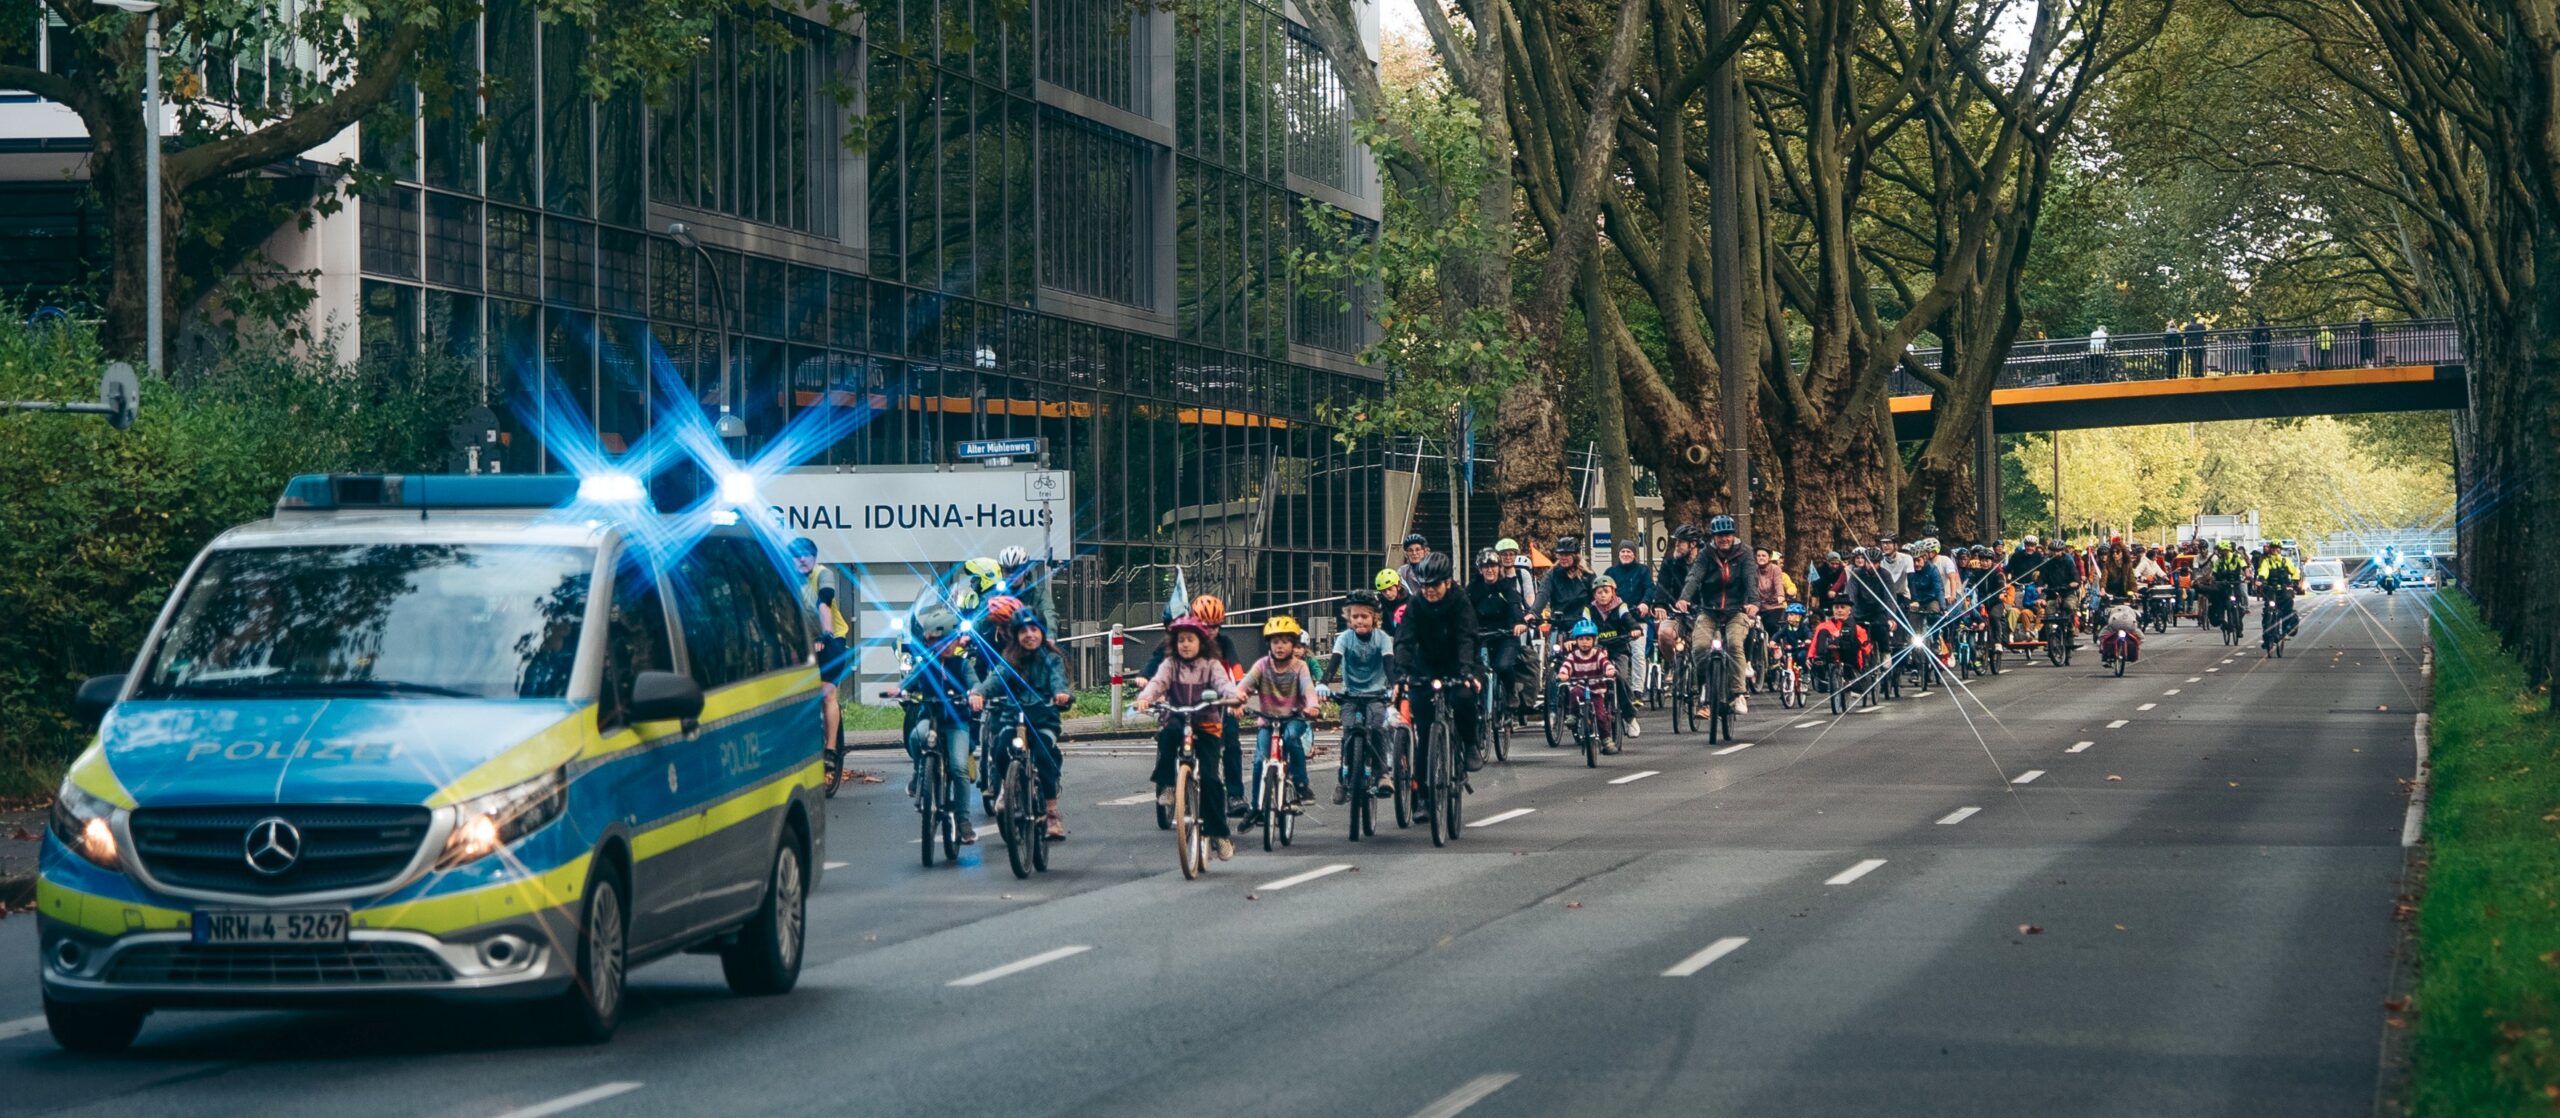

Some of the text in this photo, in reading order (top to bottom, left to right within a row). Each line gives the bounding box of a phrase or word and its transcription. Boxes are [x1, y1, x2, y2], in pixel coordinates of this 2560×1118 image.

[966, 444, 985, 454] Alter
[766, 503, 1054, 530] GNAL IDUNA-Haus
[185, 739, 403, 762] POLIZEI
[719, 731, 763, 777] POLIZEI
[207, 915, 249, 940] NRW
